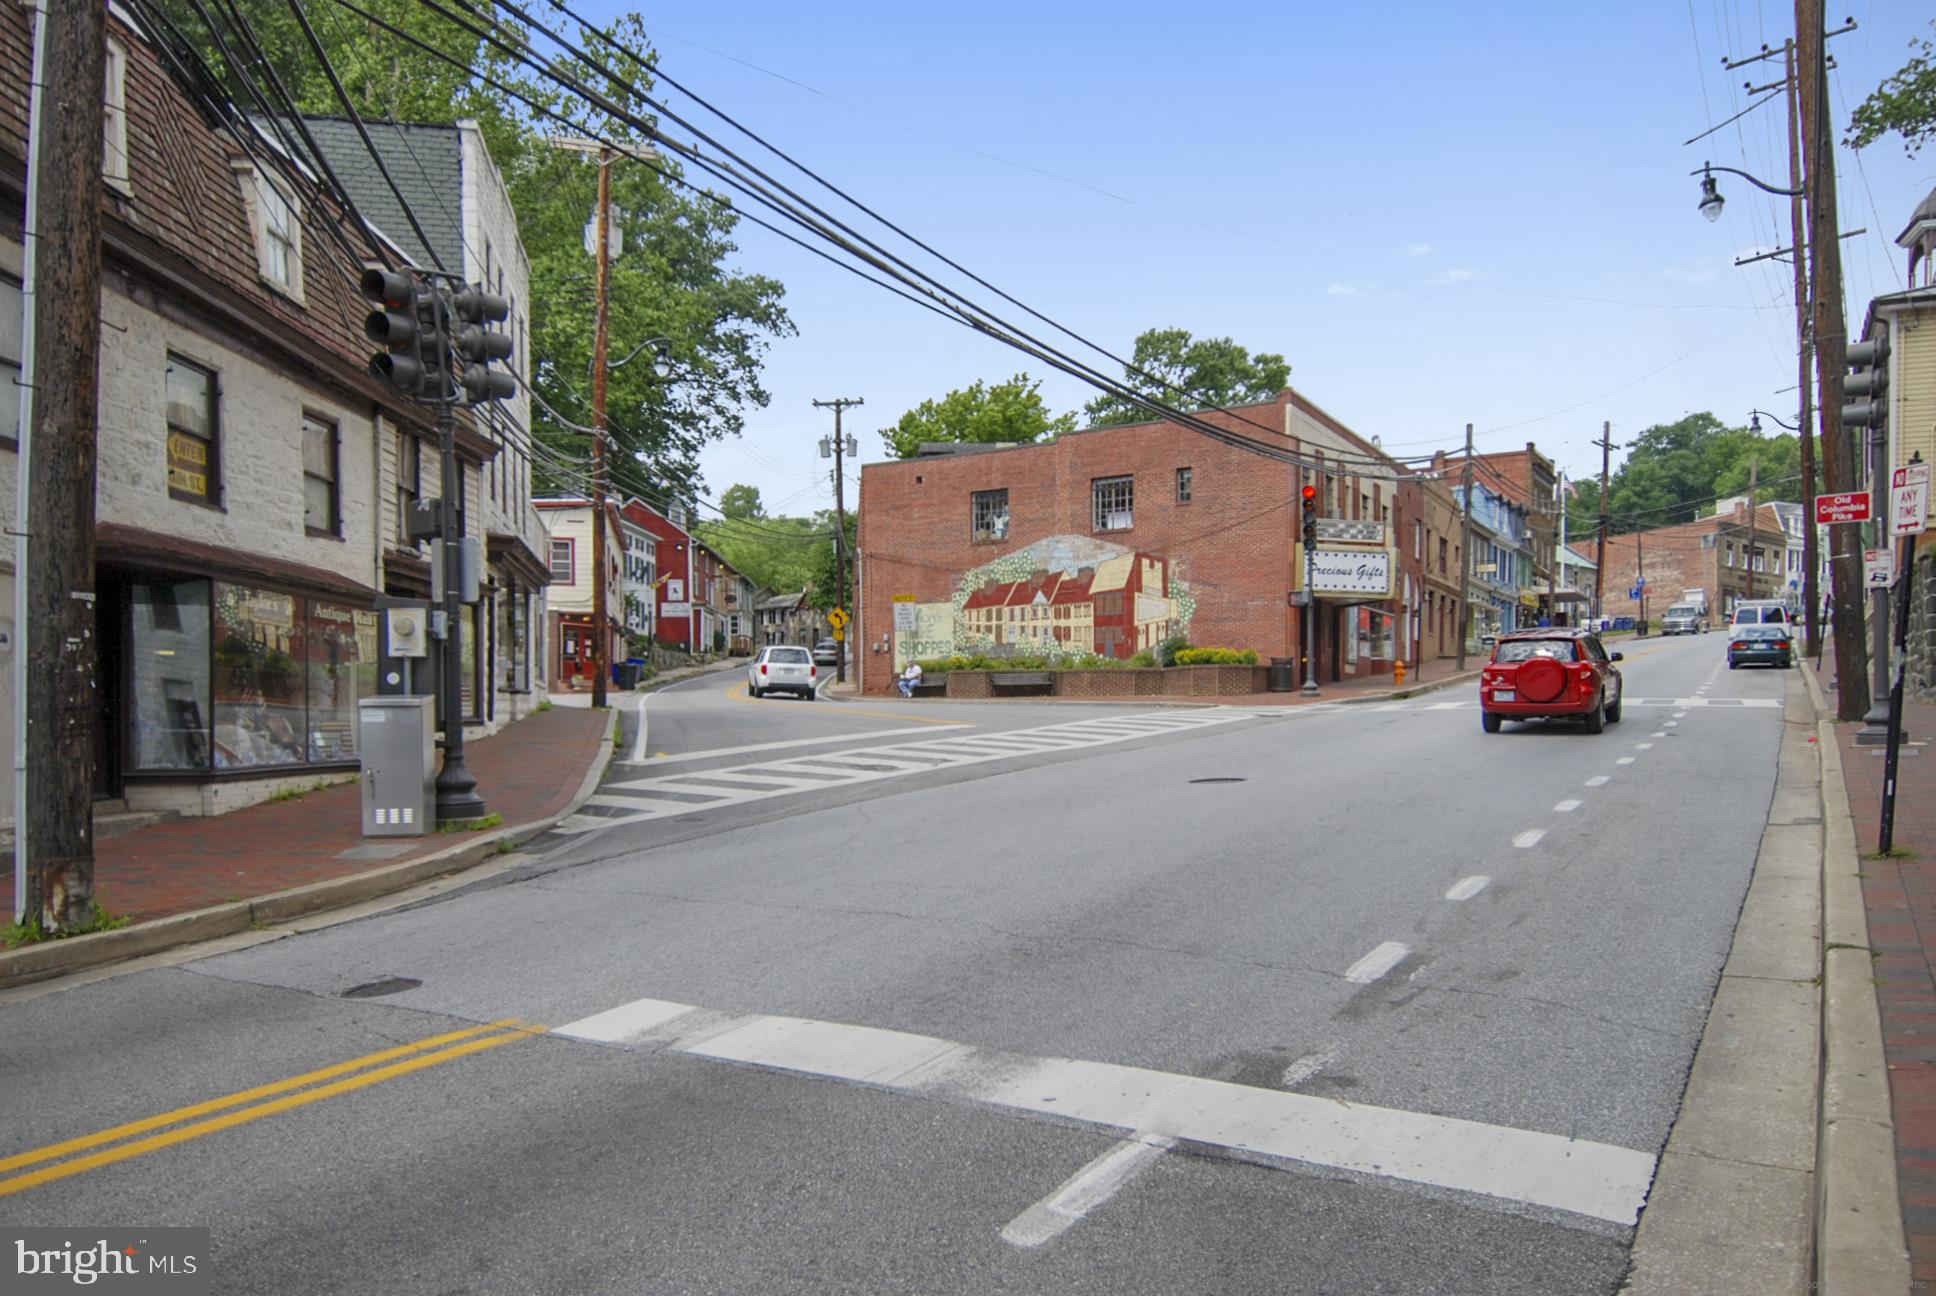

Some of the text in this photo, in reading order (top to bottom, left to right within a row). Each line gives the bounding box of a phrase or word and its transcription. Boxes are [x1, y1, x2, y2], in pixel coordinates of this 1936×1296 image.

[174, 438, 204, 462] ENTER
[1834, 496, 1851, 505] Old
[1901, 489, 1918, 503] ANY
[1820, 503, 1866, 514] Columbia
[1899, 505, 1918, 519] TIME
[1832, 513, 1853, 521] Pike
[1356, 564, 1384, 581] Gifts
[315, 603, 351, 624] Antique
[899, 640, 952, 656] SHOPPES
